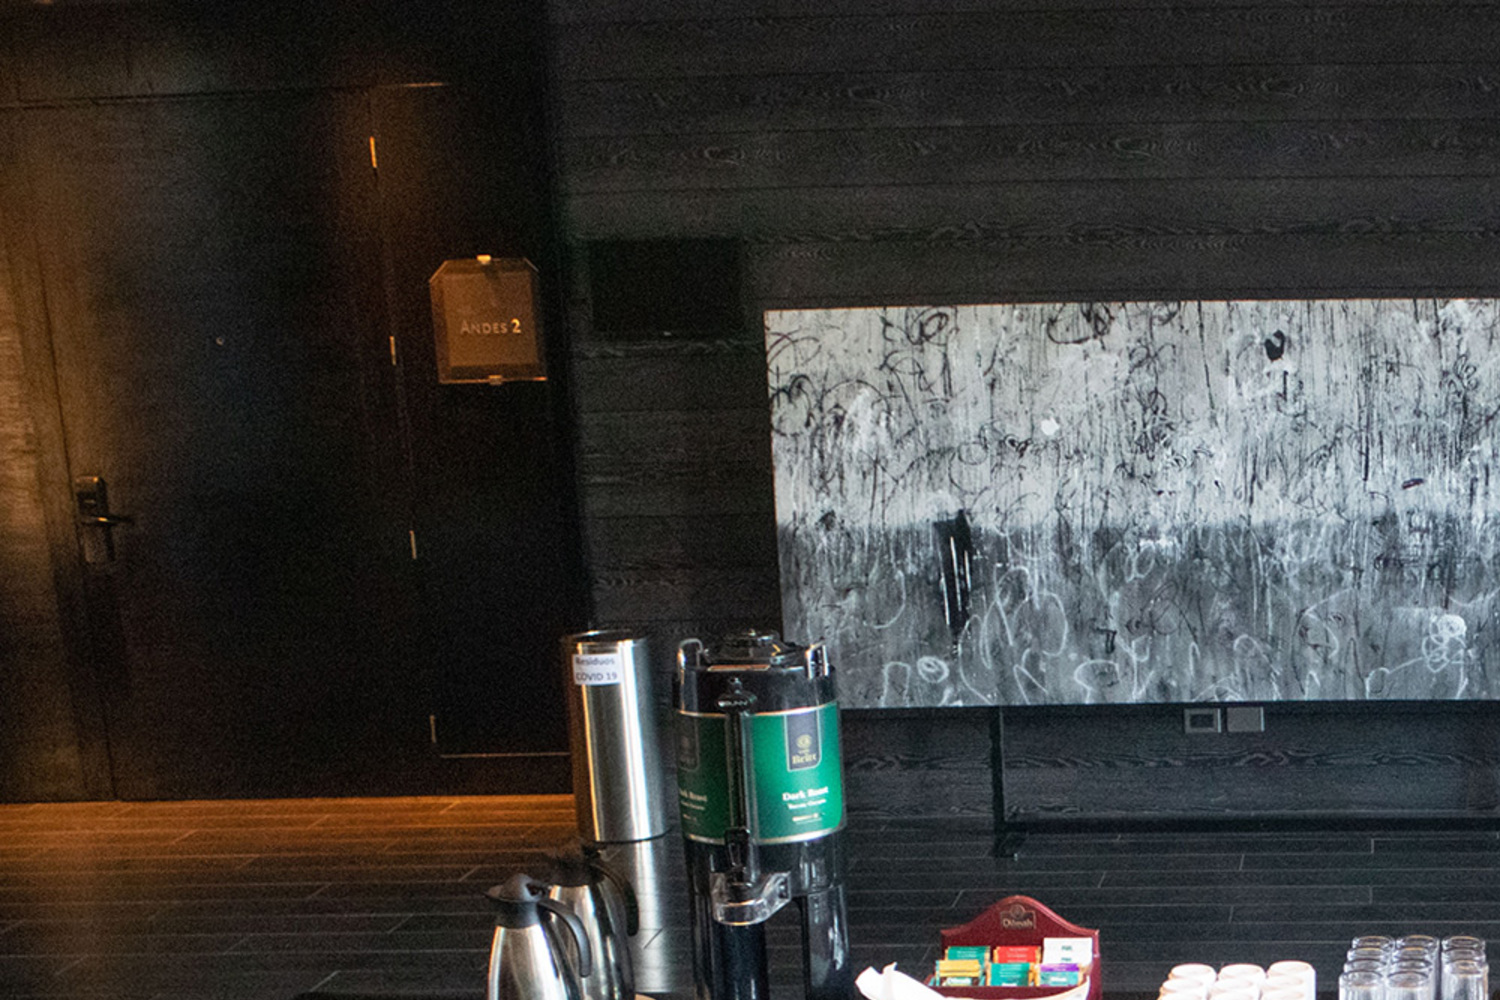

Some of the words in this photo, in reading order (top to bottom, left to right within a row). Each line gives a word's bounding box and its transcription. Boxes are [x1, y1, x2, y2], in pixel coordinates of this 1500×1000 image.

[510, 318, 522, 334] 2
[575, 671, 604, 681] COVID
[606, 671, 618, 681] 19
